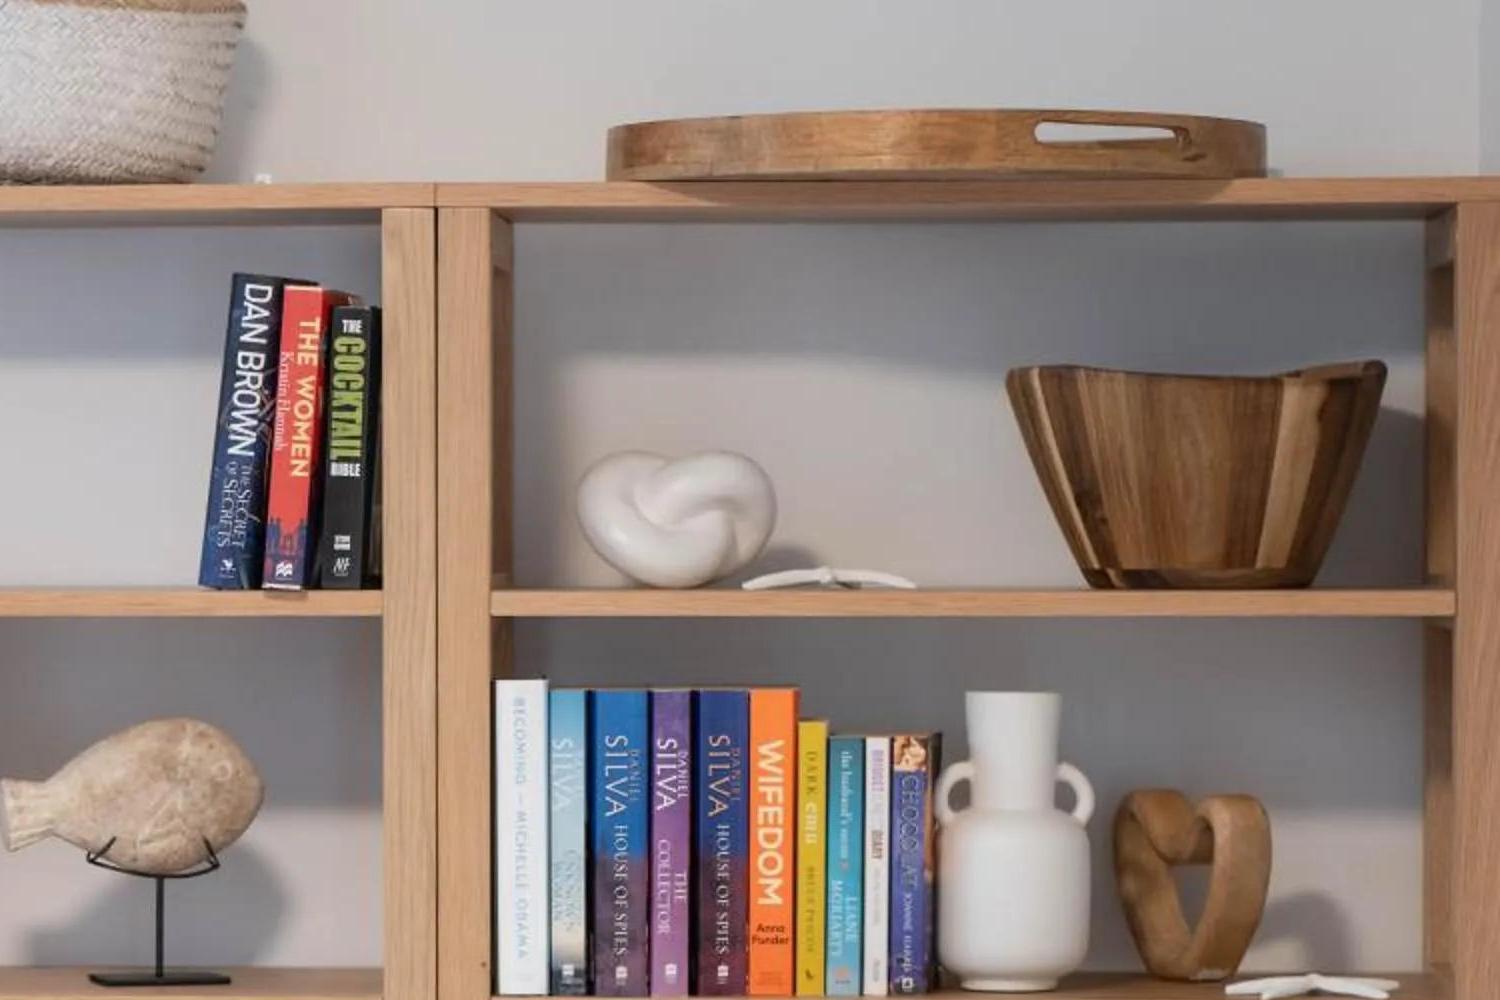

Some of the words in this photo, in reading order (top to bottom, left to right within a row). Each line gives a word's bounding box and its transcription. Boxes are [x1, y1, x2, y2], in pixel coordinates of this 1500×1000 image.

[239, 283, 274, 344] DAN
[297, 317, 321, 366] THE
[342, 319, 363, 333] THE
[279, 351, 295, 397] Kristin
[329, 337, 366, 461] COCKTAIL
[227, 351, 265, 457] BROWN
[275, 399, 291, 452] Hannah
[291, 376, 316, 478] WOMEN
[217, 479, 238, 548] SECRETS
[232, 489, 253, 549] SECRET
[513, 696, 527, 786] BECOMING
[841, 751, 852, 769] the
[552, 737, 573, 812] SILVA
[605, 735, 629, 818] SILVA
[657, 737, 678, 811] SILVA
[677, 751, 689, 799] DANIEL
[708, 735, 730, 818] SILVA
[806, 751, 818, 796] DARK
[515, 810, 529, 890] MICHELLE
[757, 739, 784, 905] WIFEDOM
[900, 775, 919, 889] CHOCOLAT
[614, 825, 629, 881] HOUSE
[716, 825, 730, 881] HOUSE
[614, 886, 629, 906] OF
[657, 839, 671, 936] COLLECTOR
[675, 870, 688, 901] THE
[716, 885, 730, 906] OF
[515, 899, 529, 960] OBAMA
[614, 912, 629, 955] SPIES
[716, 912, 730, 955] SPIES
[752, 934, 789, 945] Funder
[756, 923, 786, 932] Anna
[831, 880, 843, 957] MORIARTY
[845, 895, 857, 942] LIANE
